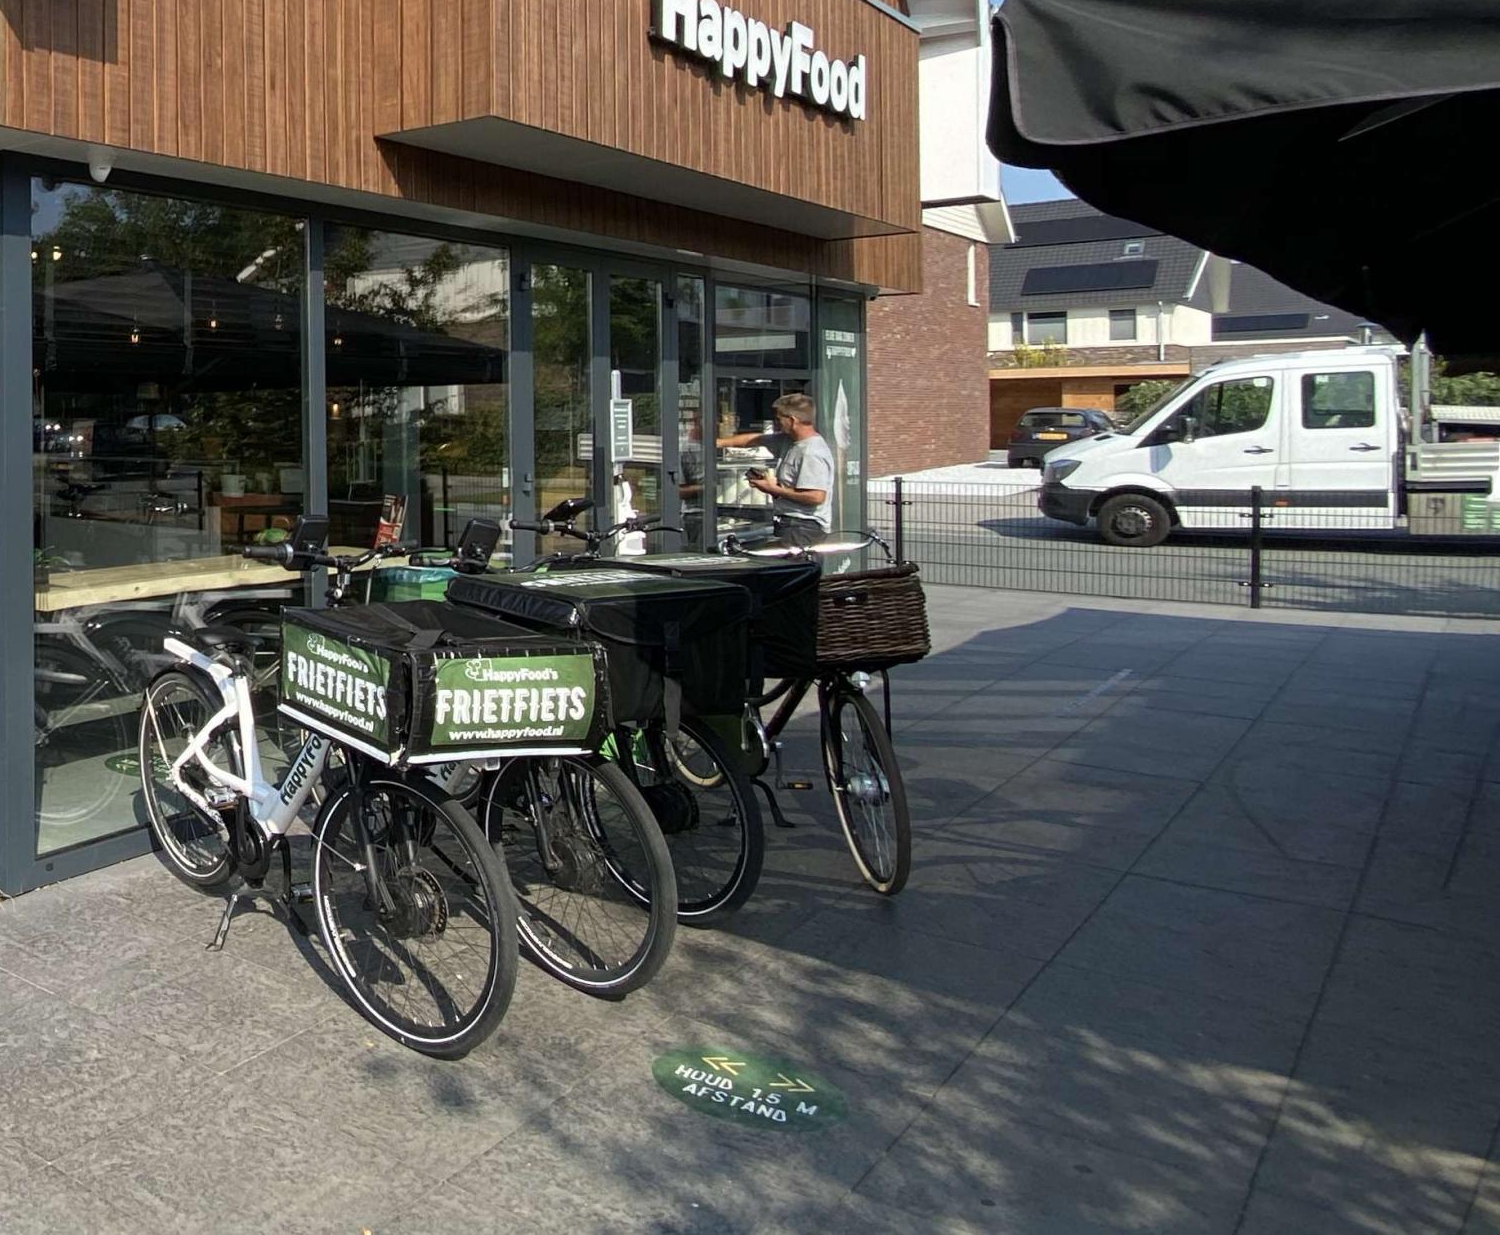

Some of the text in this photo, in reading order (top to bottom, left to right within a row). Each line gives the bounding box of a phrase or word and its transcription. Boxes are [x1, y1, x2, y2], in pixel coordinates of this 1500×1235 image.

[288, 651, 387, 721] FRIETFIETS
[482, 668, 559, 683] HappyFood's
[296, 691, 374, 732] www.happyfood.nl
[435, 686, 587, 725] FRIETFIETS
[448, 725, 565, 741] www.happyfood.nl
[674, 1064, 818, 1116] HOUD 1.5 M
[682, 1083, 787, 1122] AFSTAND
